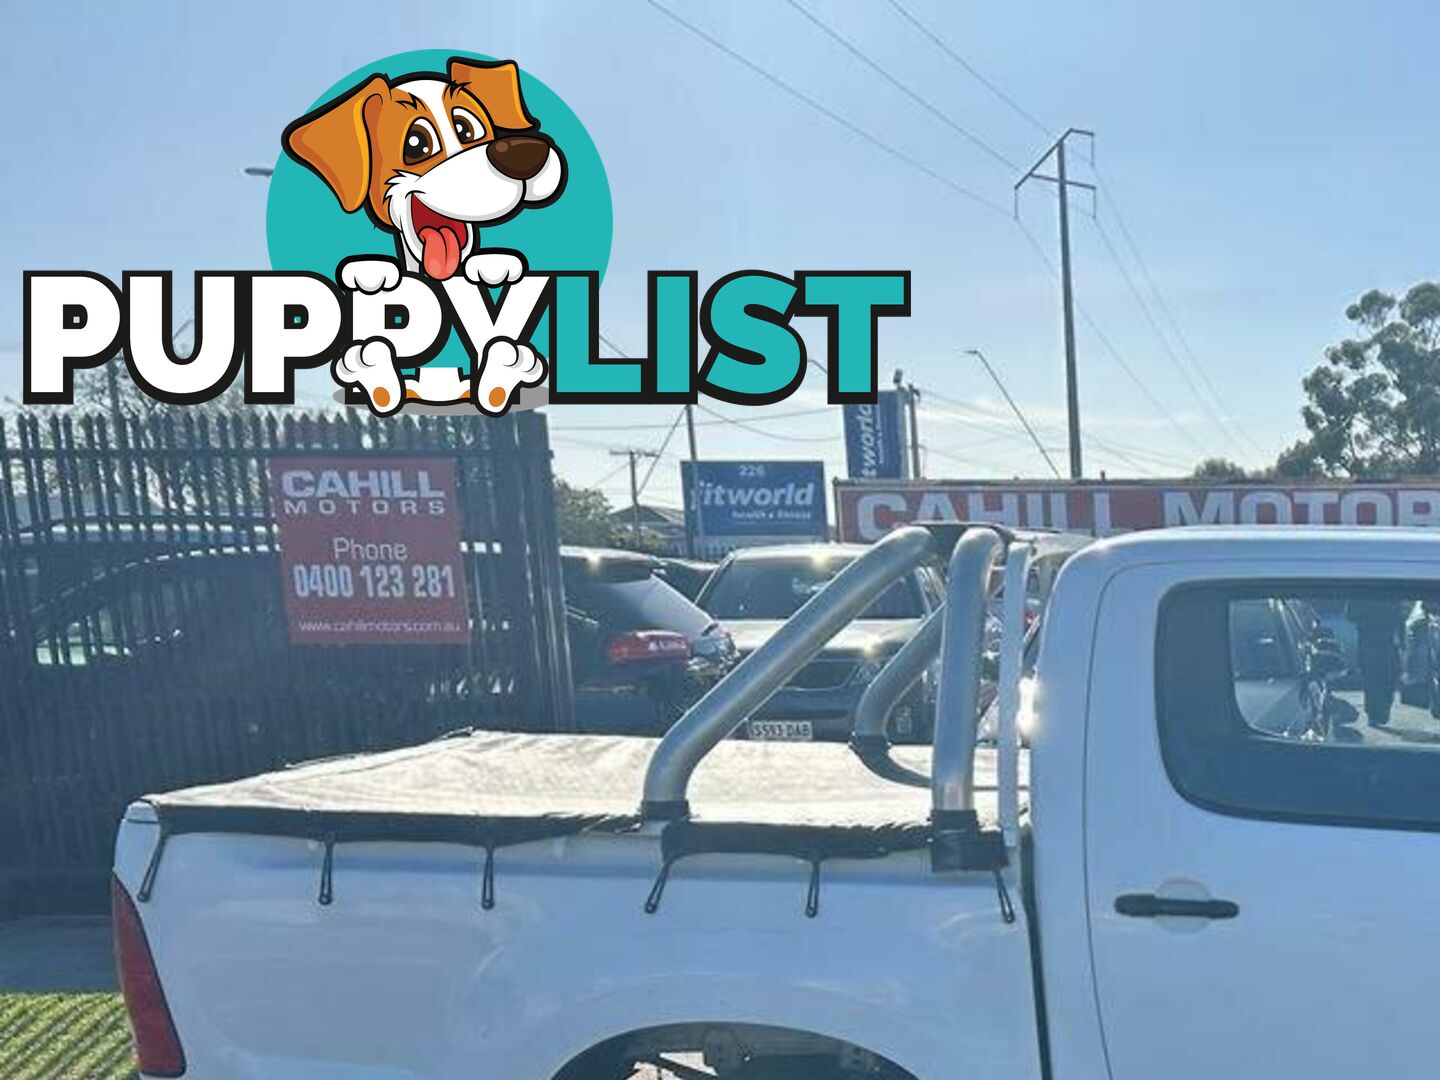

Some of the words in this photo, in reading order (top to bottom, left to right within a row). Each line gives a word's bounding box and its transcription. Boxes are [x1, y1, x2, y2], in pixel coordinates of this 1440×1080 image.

[282, 469, 445, 498] CAHILL
[284, 500, 446, 514] MOTORS
[857, 491, 1137, 541] CAHILL
[333, 537, 408, 560] Phone
[293, 564, 353, 598] 0400
[360, 564, 403, 598] 123
[412, 564, 455, 598] 281
[299, 619, 460, 632] www.cahillmotors.com.au
